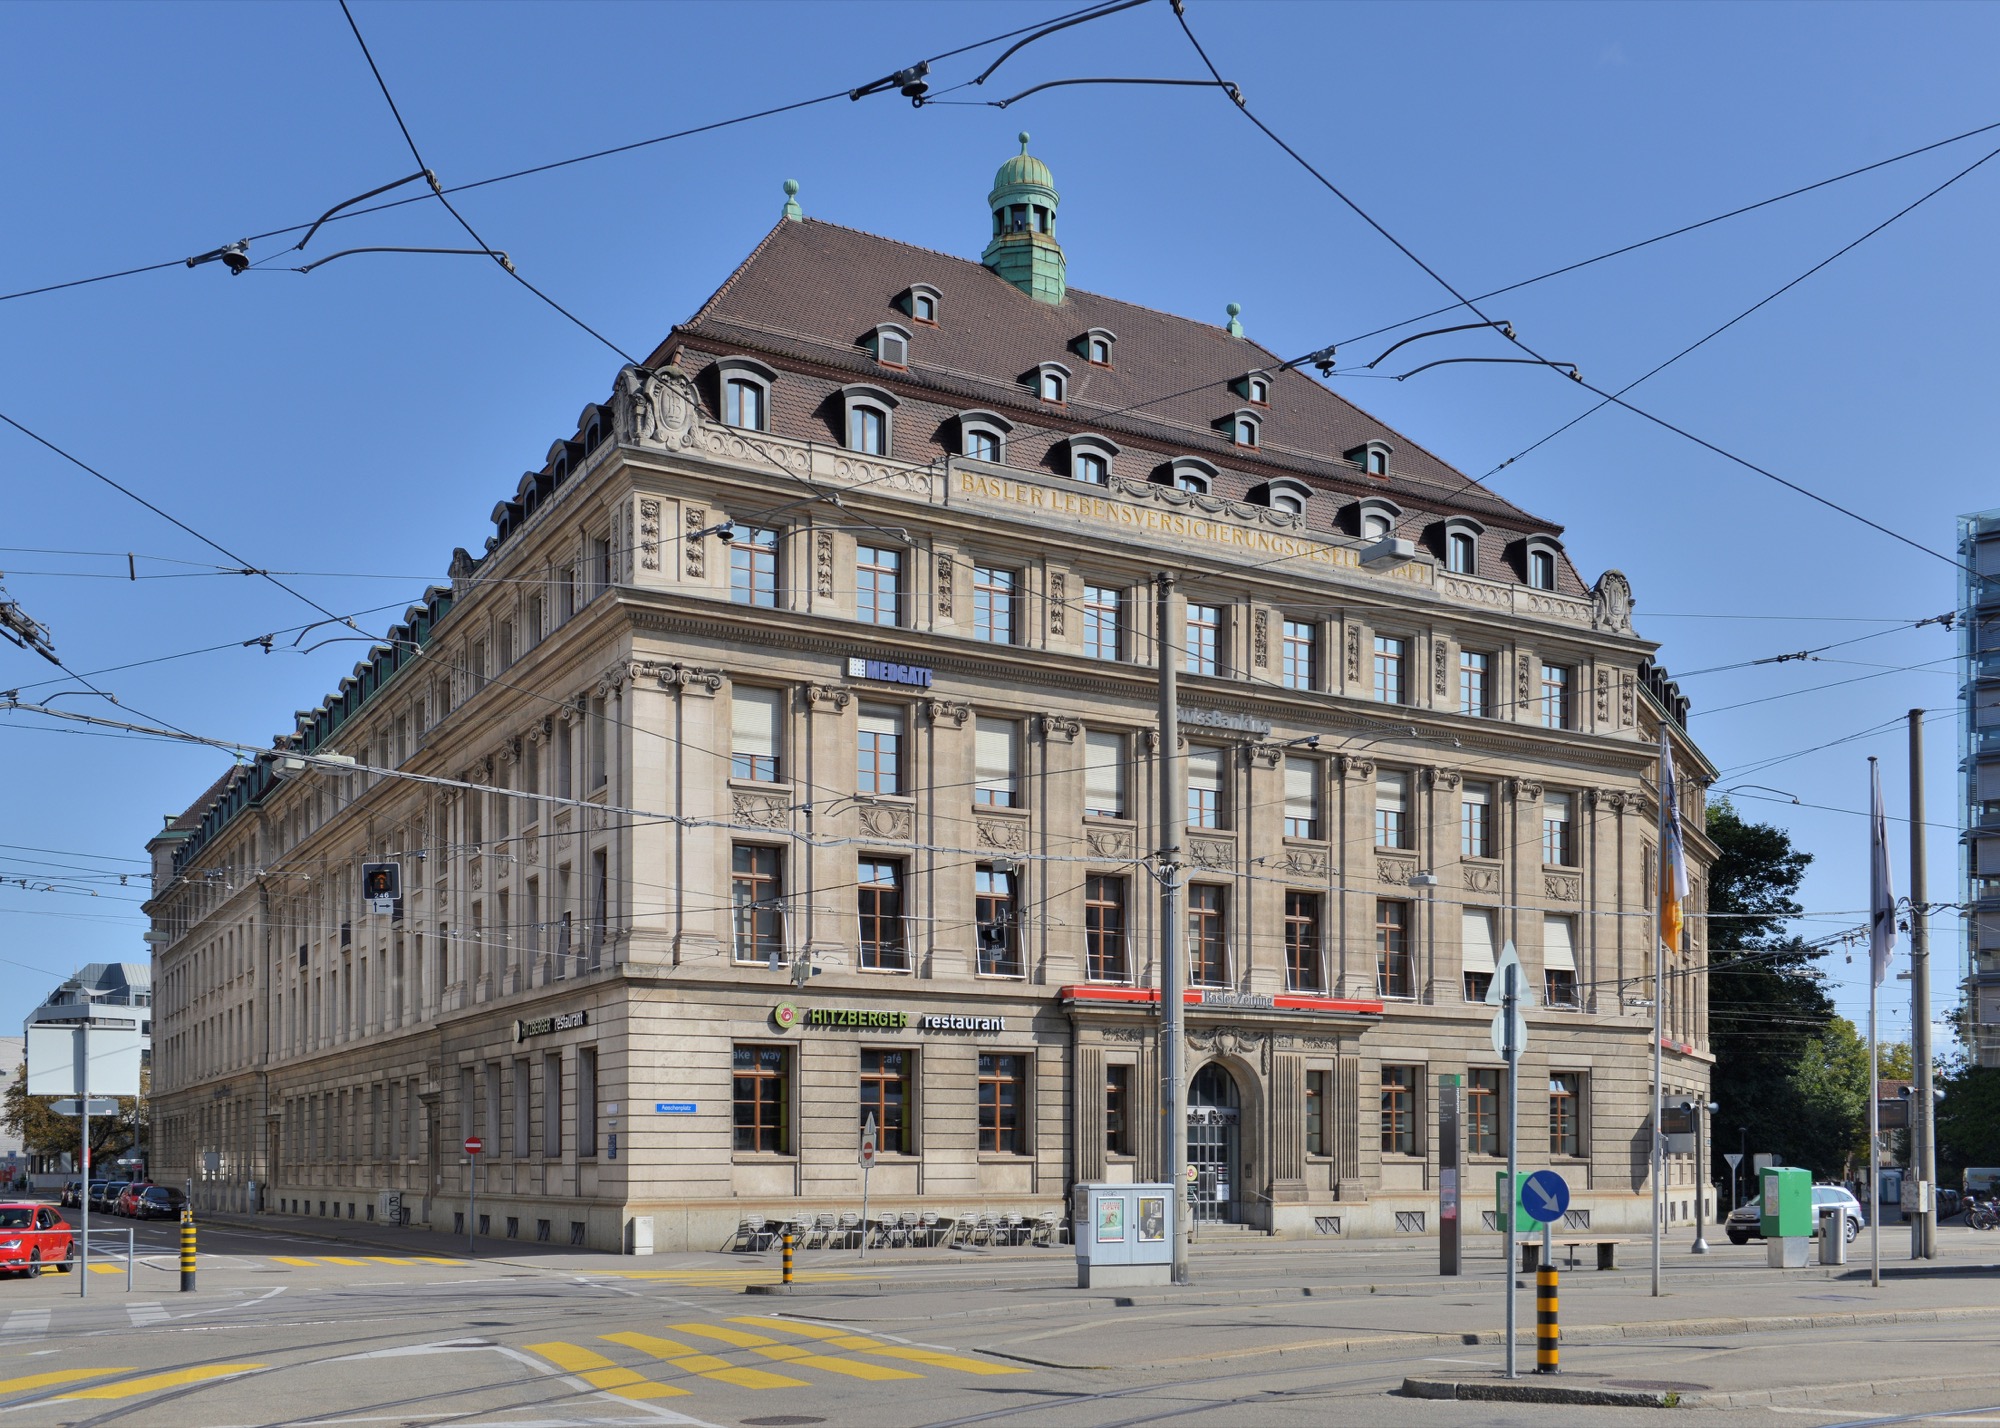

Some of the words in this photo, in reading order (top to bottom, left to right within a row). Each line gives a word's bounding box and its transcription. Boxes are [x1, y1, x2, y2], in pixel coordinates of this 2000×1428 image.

[961, 473, 1044, 508] BASLER
[1052, 490, 1426, 583] LEBENSVERSICHERUNGSGESELLAFT
[866, 660, 933, 687] MEDGATE
[1204, 989, 1235, 1004] Basler
[1236, 991, 1274, 1010] Zeitung
[554, 1011, 584, 1031] restaurant
[810, 1009, 909, 1028] HITZBERGER
[924, 1014, 1006, 1032] restaurant
[733, 1049, 751, 1060] ake
[661, 1104, 692, 1112] Aeschenplatz
